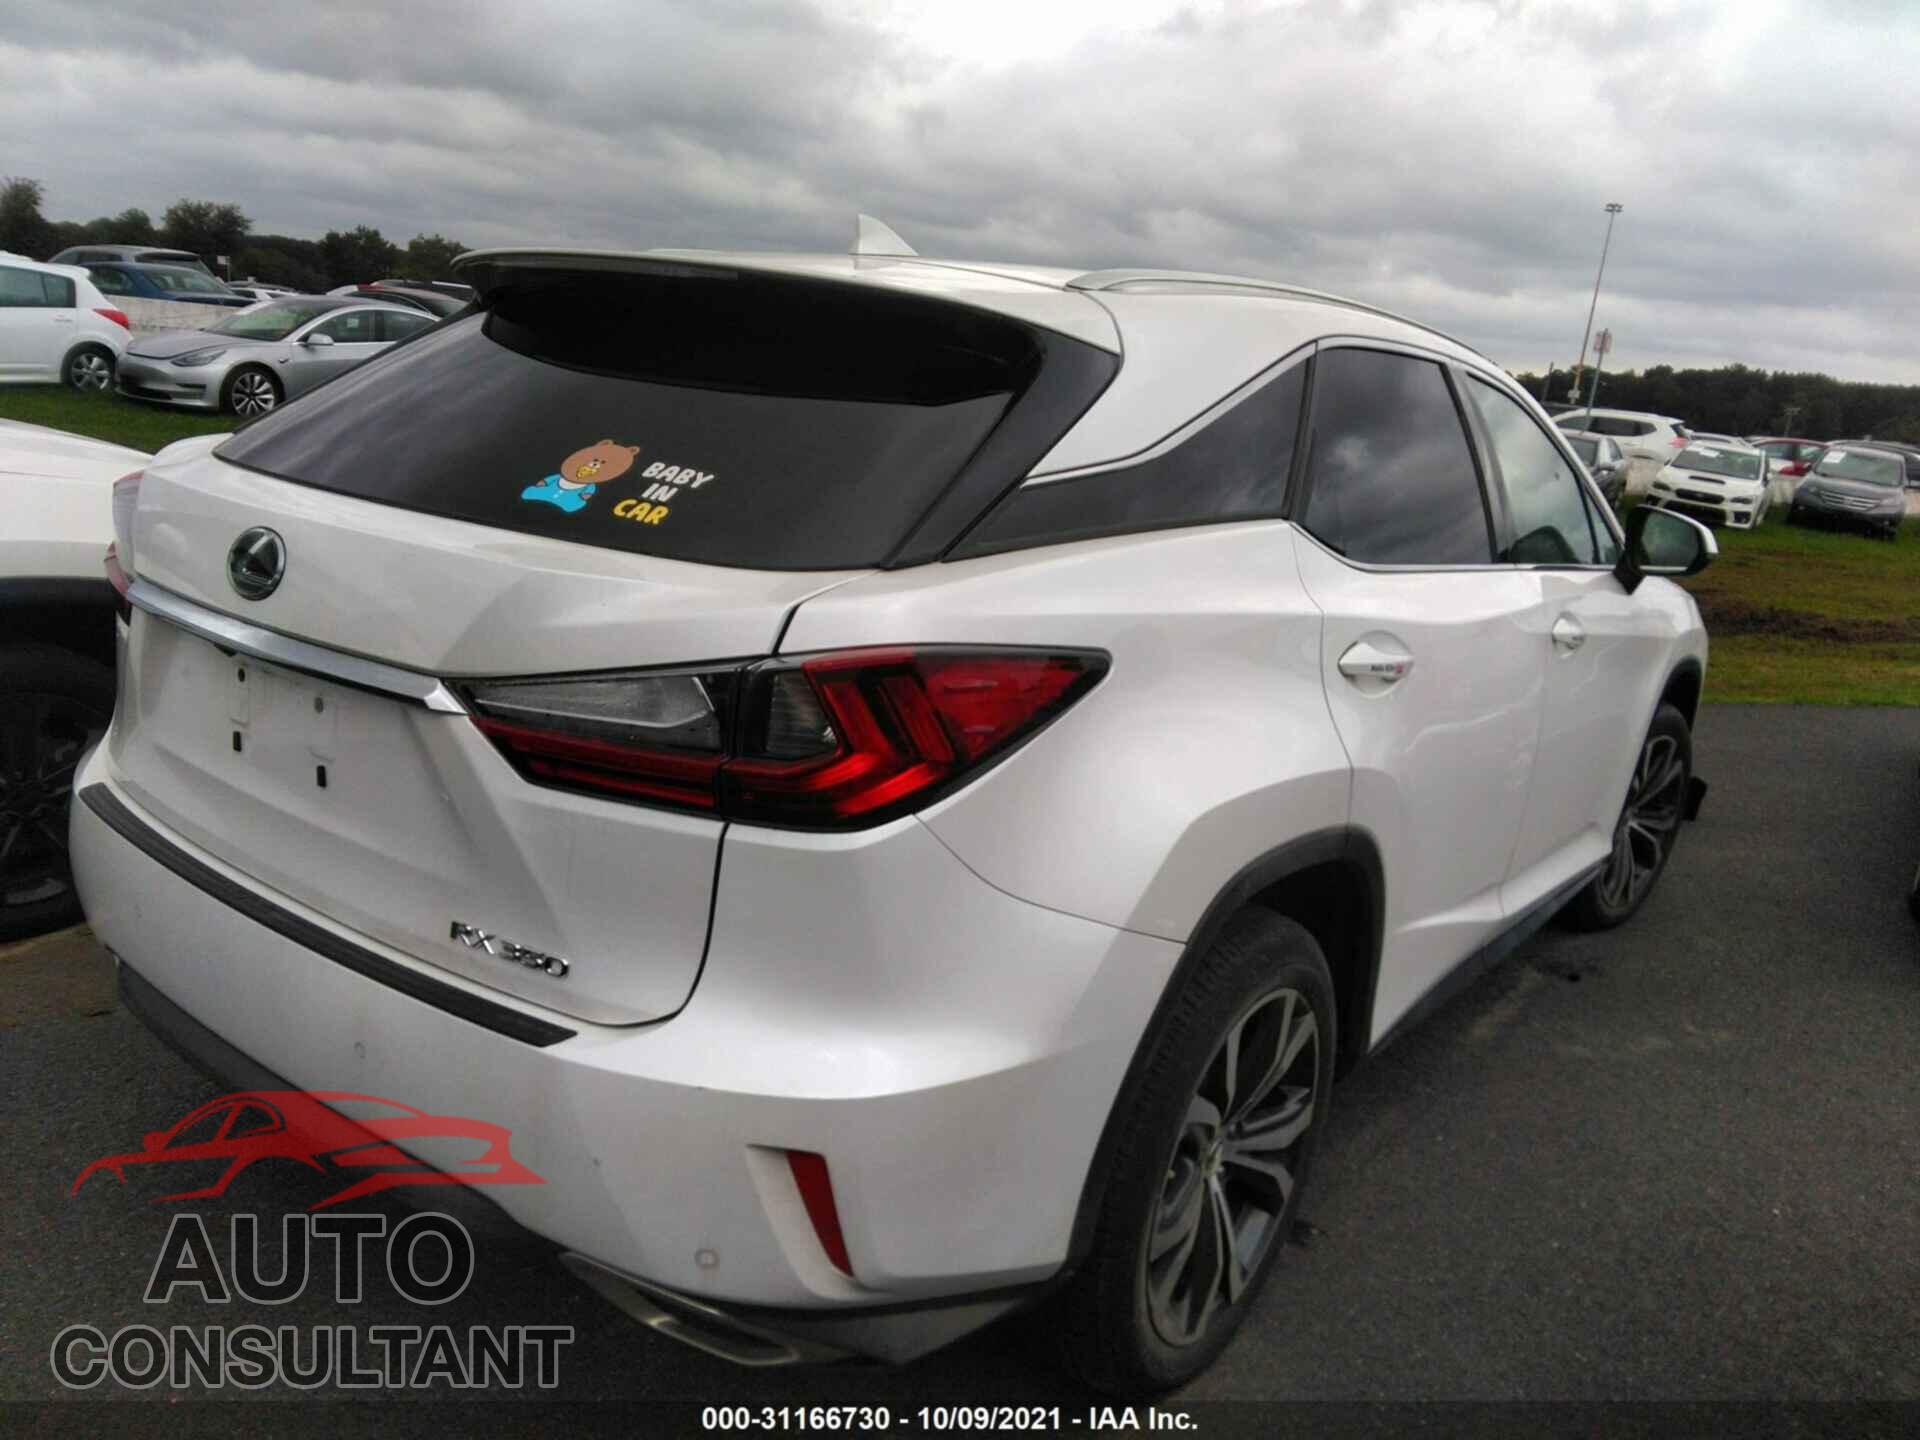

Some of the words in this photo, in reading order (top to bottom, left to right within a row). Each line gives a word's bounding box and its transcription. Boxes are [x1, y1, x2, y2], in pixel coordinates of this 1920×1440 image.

[642, 462, 714, 488] BABY
[641, 483, 678, 502] IN
[613, 499, 669, 524] CAR
[450, 921, 496, 955] RX
